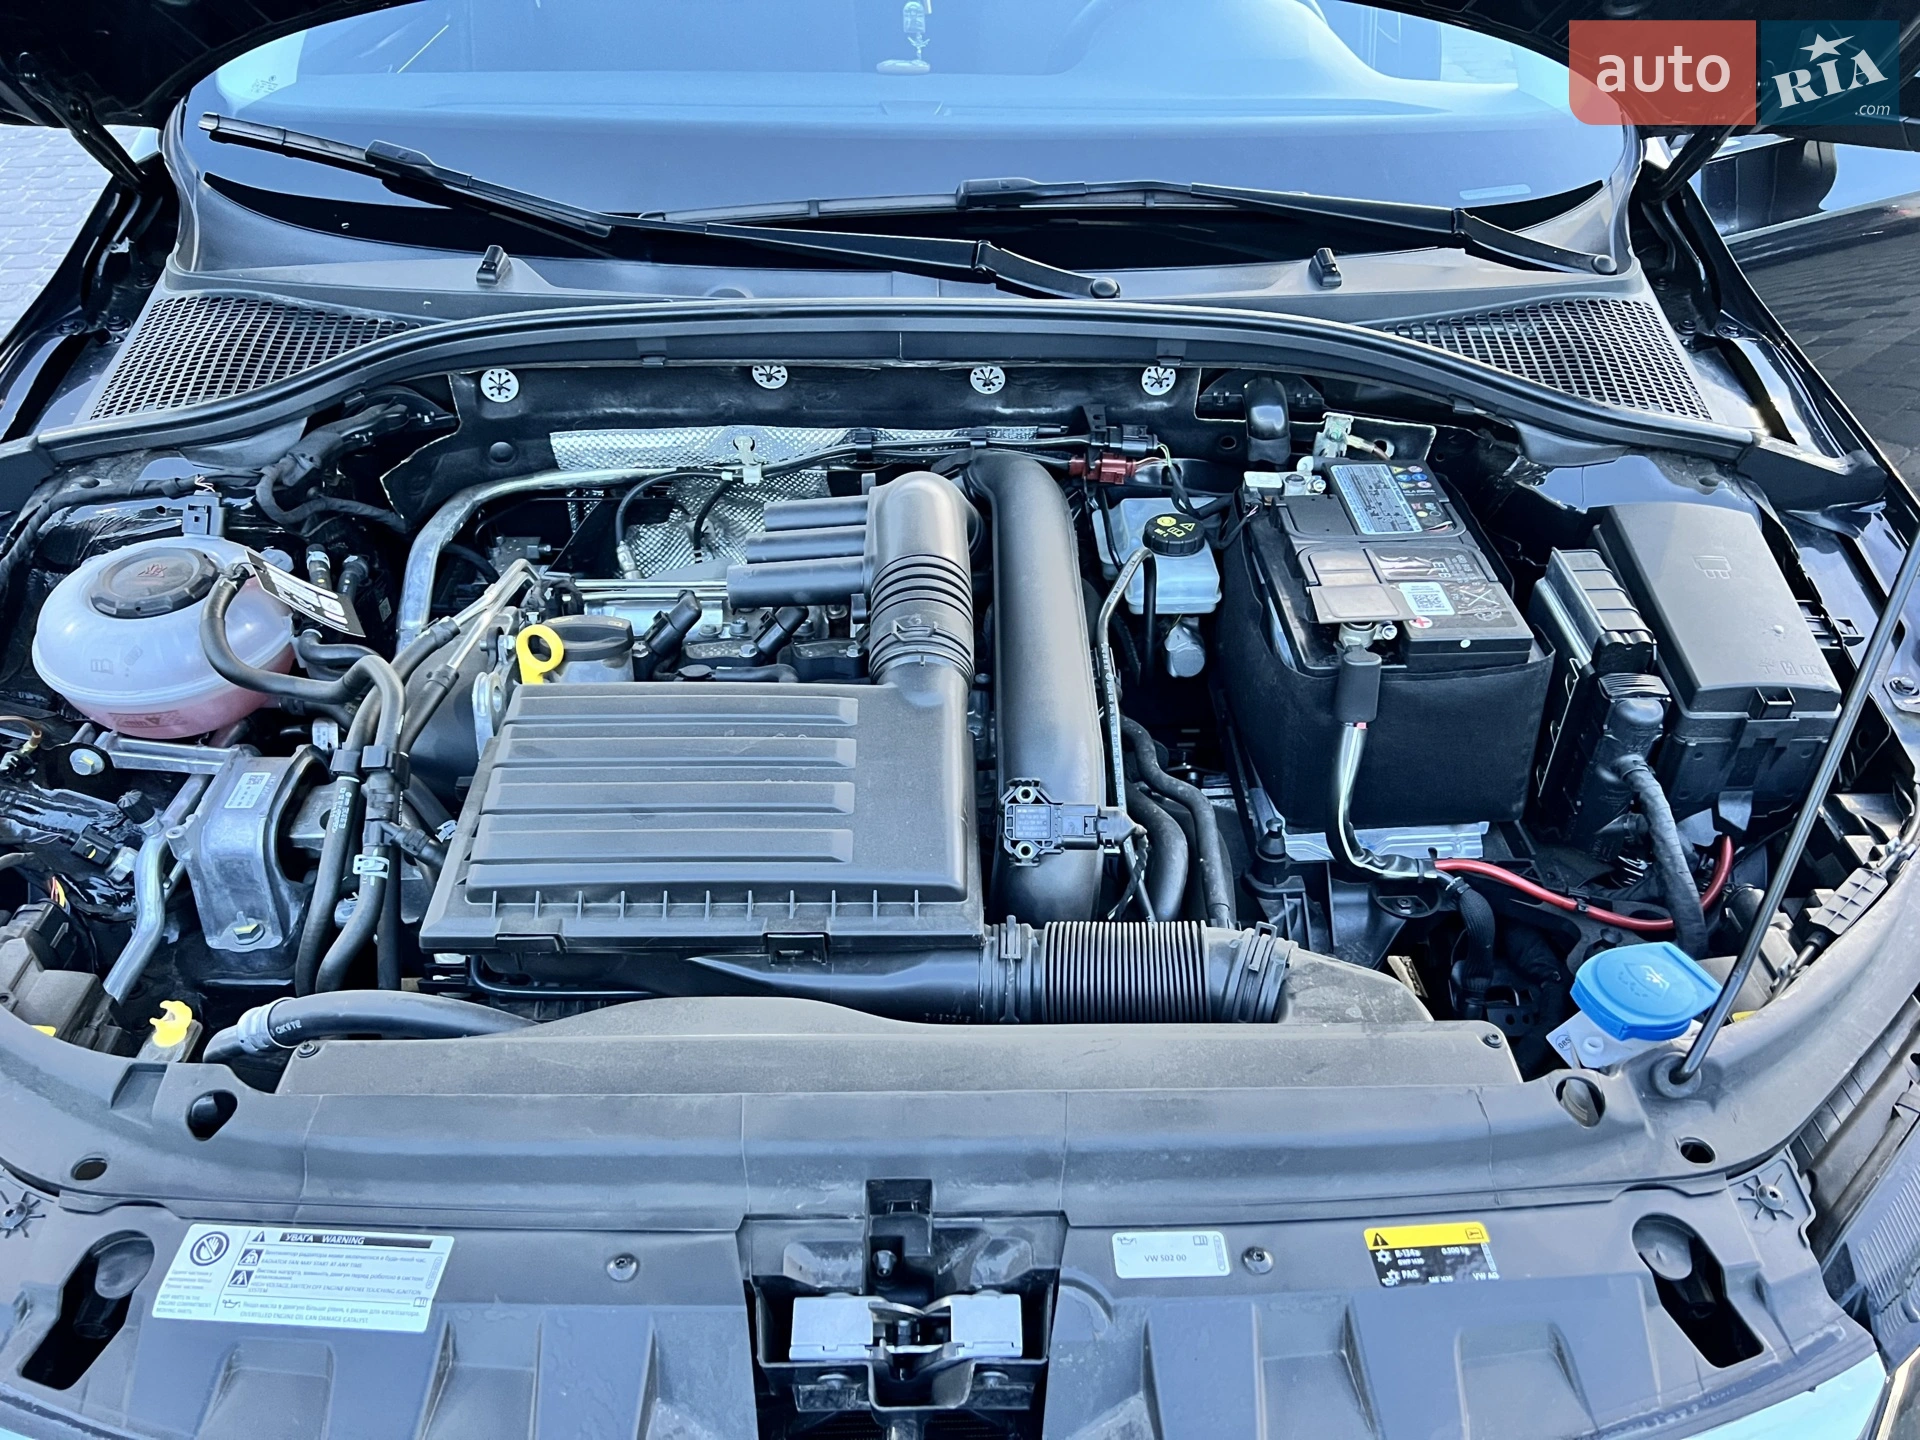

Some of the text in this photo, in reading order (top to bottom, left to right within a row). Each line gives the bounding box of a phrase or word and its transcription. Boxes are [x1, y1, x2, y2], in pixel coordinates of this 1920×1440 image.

[1432, 561, 1452, 578] EFB
[285, 1233, 364, 1244] УВАГА WARNING
[1144, 1254, 1158, 1262] VW
[1160, 1254, 1174, 1262] 502
[1401, 1269, 1420, 1279] PAG
[1472, 1272, 1500, 1280] VW AG
